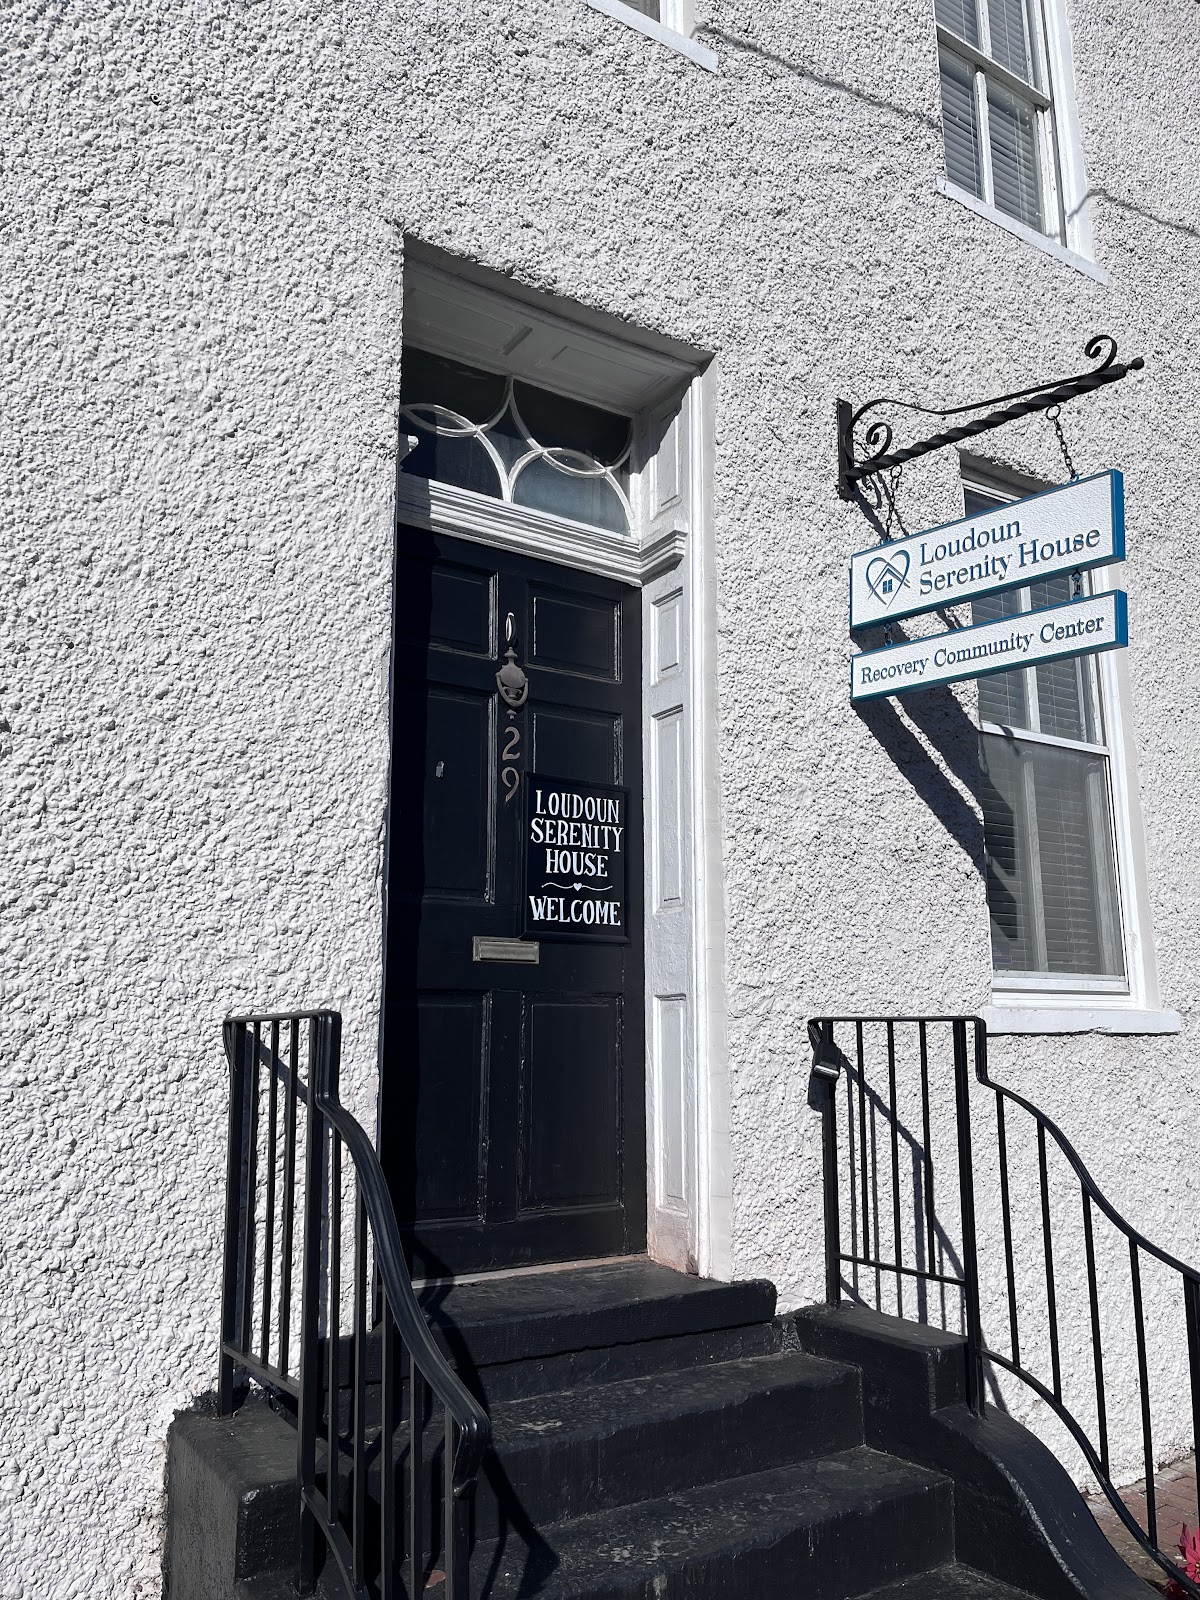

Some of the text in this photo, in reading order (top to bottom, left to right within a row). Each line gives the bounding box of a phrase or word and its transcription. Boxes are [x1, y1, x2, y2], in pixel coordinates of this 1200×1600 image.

[919, 520, 1022, 566] Loudoun
[919, 528, 1101, 596] Serenity House
[860, 616, 1105, 685] Recovery Community Center
[535, 789, 620, 824] LOUDOUN
[530, 817, 624, 852] SERENITY
[545, 848, 609, 877] HOUSE
[528, 895, 622, 926] WELCOME
